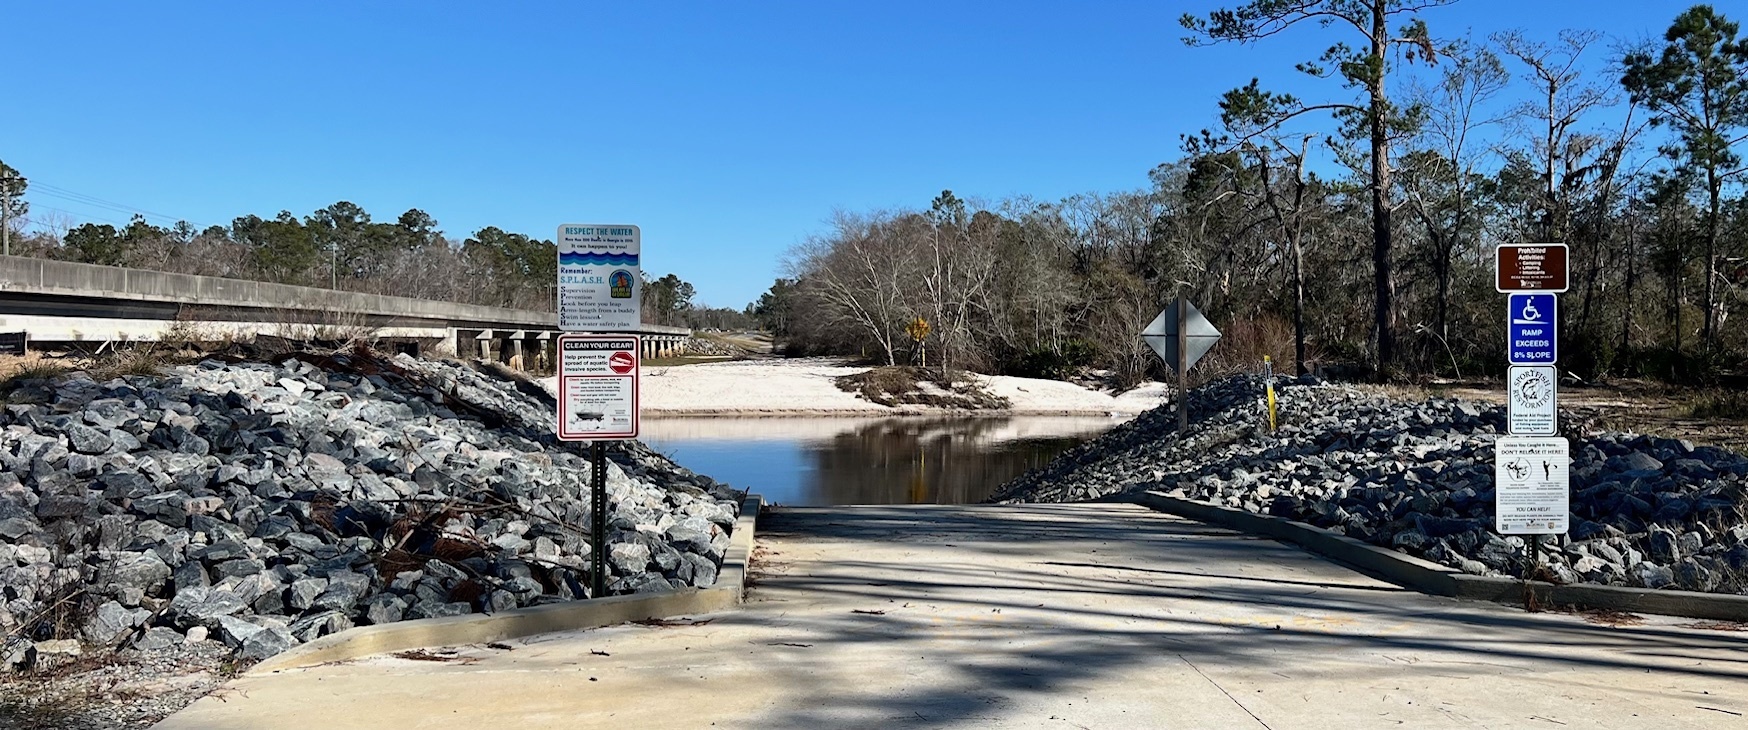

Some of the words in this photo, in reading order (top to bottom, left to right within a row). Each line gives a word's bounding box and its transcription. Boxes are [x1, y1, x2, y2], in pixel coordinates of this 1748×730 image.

[565, 227, 594, 235] RESPECT
[596, 228, 608, 236] THE
[610, 228, 633, 236] WATER
[560, 267, 593, 275] Remember:
[560, 276, 604, 284] S.P.L.A.S.H.
[560, 286, 596, 294] Supervision
[1515, 339, 1550, 347] EXCEEDS
[1514, 351, 1526, 359] 8%
[1526, 351, 1551, 359] SLOPE
[1513, 388, 1551, 409] RESTORATION
